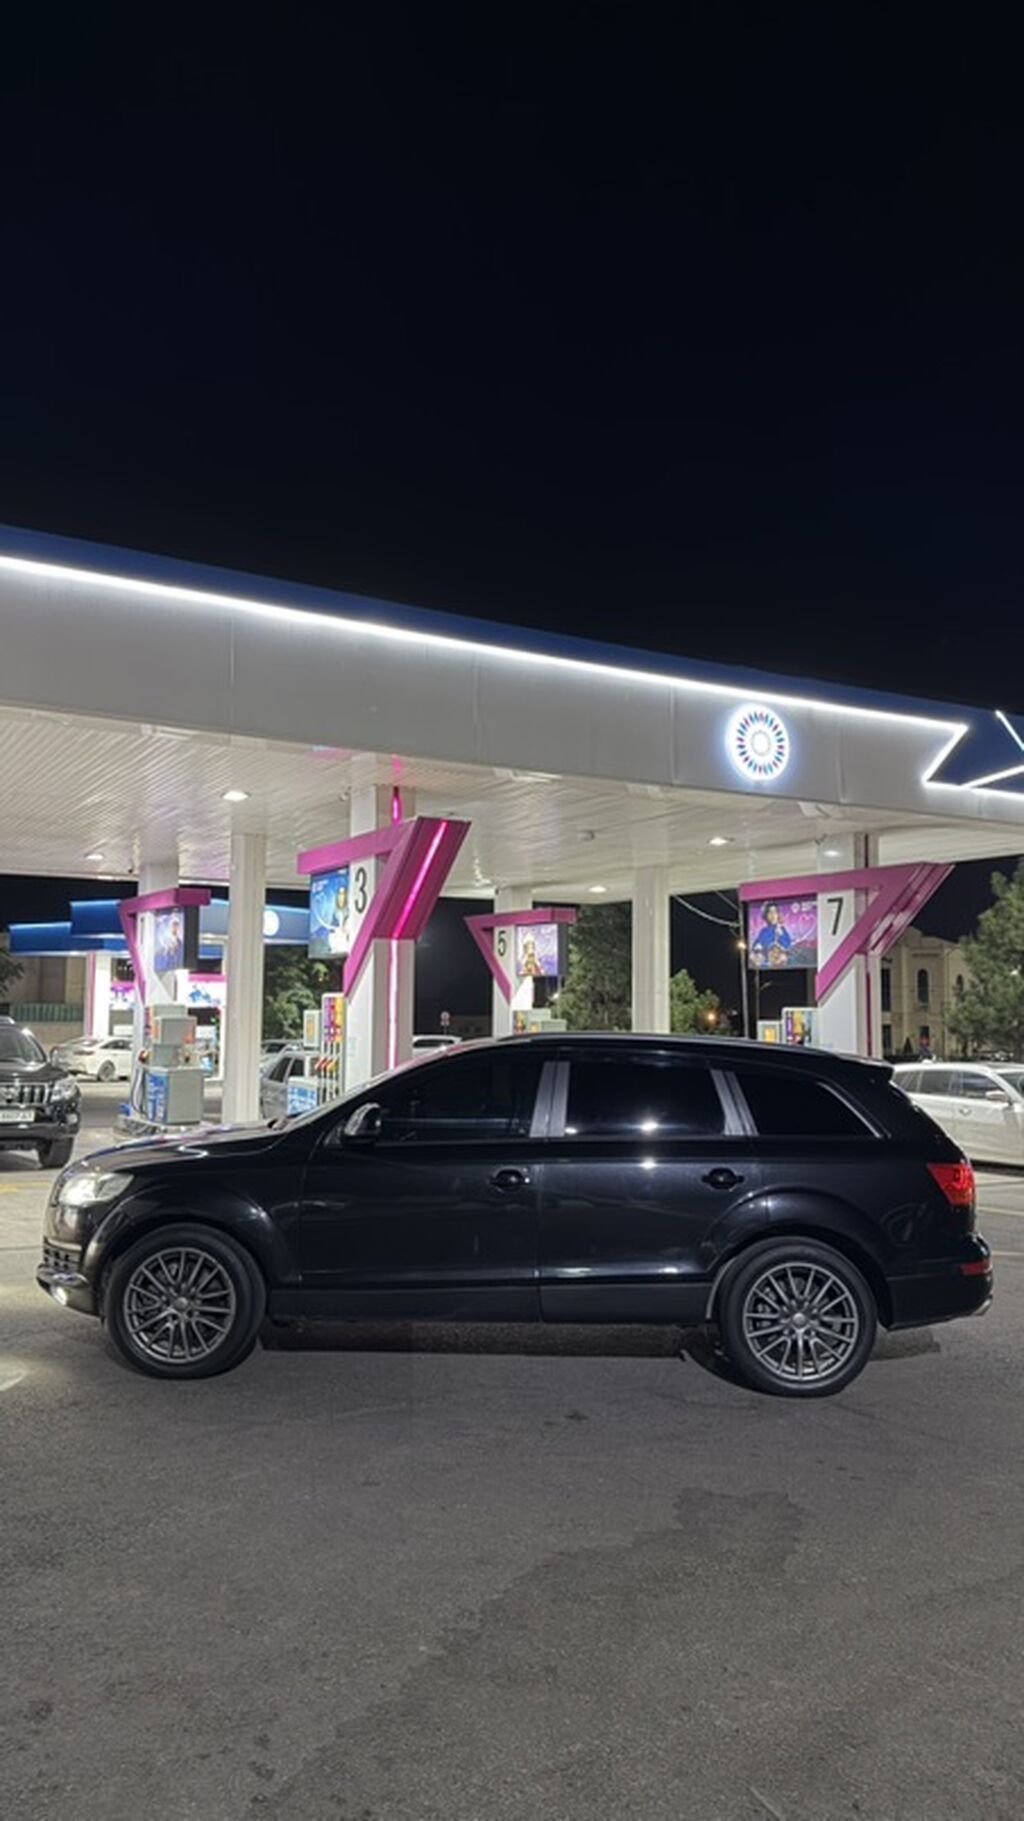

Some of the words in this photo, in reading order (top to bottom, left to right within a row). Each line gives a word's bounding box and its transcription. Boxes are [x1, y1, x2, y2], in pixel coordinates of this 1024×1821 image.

[355, 866, 368, 914] 3
[827, 896, 843, 936] 7
[497, 930, 507, 957] 5
